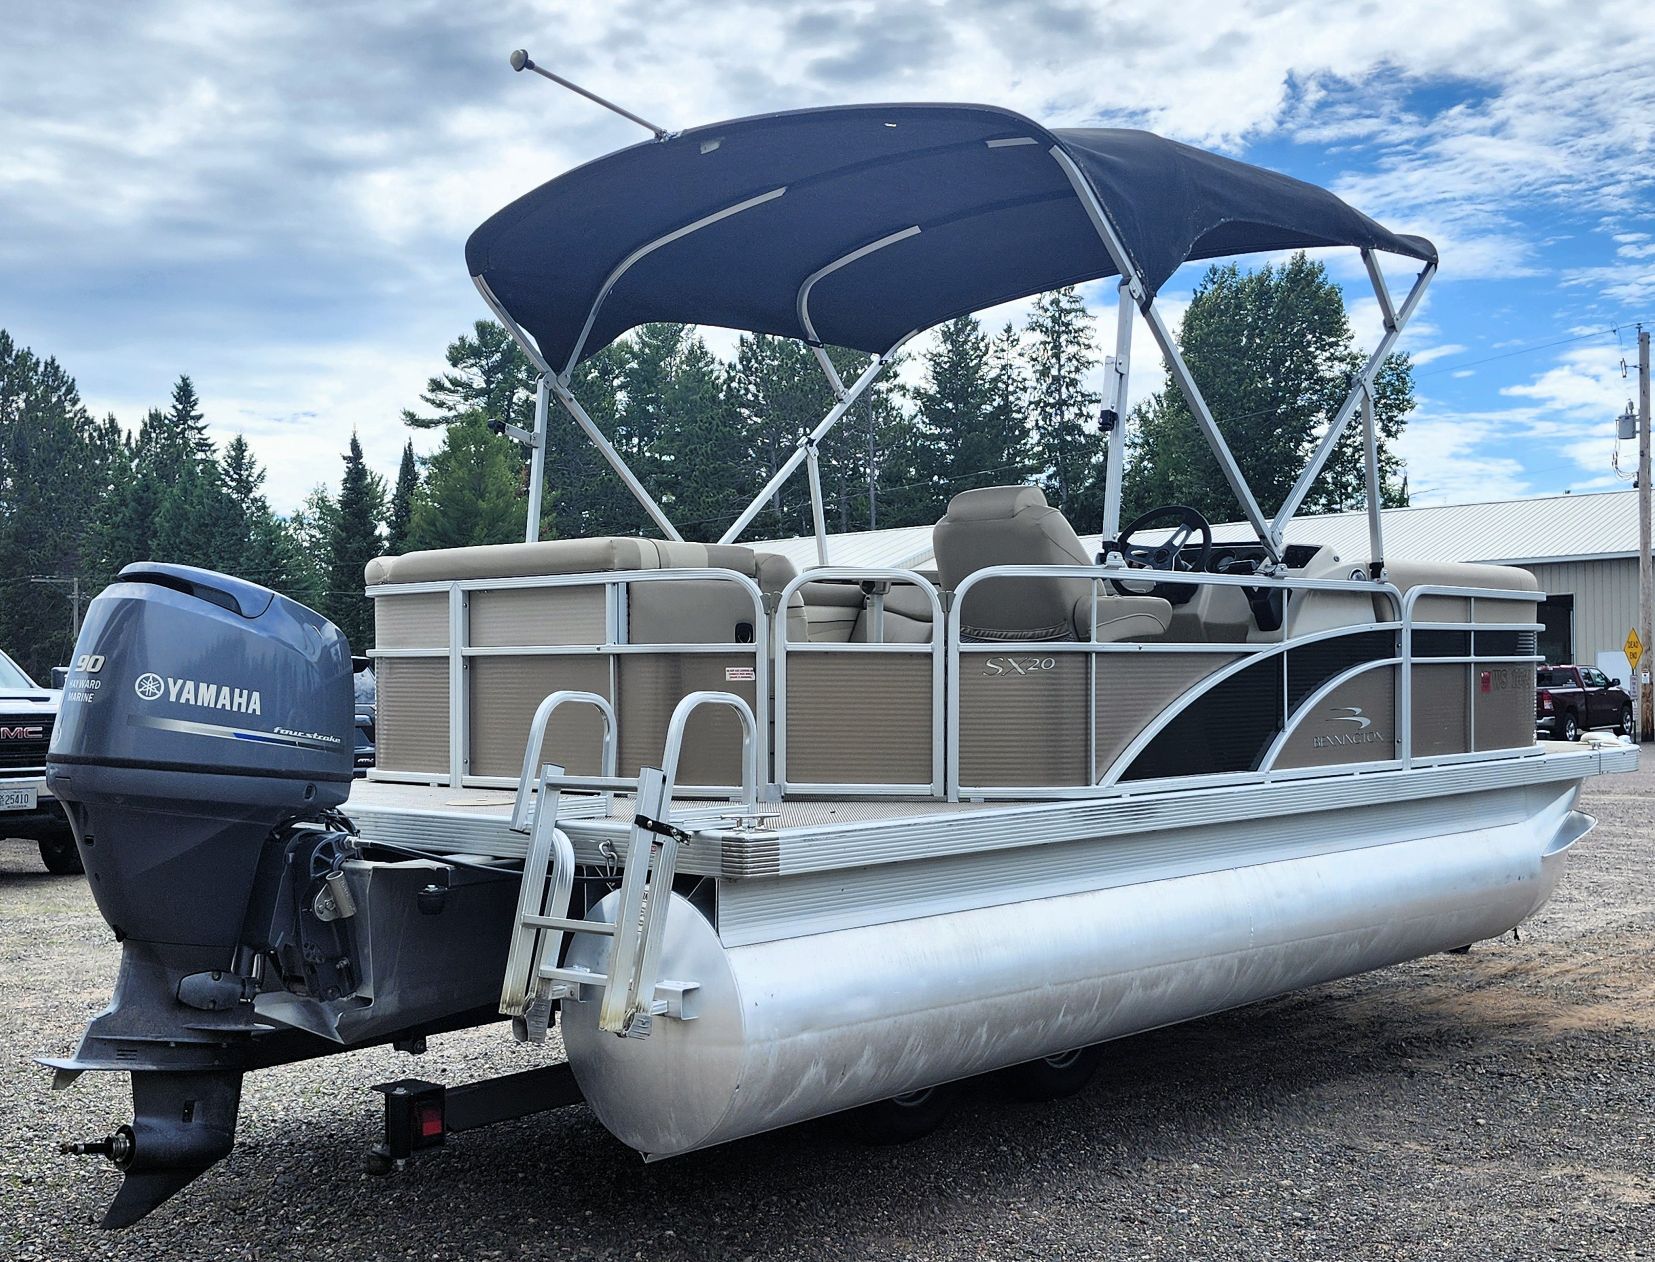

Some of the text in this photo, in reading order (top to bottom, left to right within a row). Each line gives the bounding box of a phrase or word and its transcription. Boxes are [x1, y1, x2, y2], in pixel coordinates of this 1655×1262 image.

[1627, 641, 1639, 649] DEAD
[1629, 652, 1638, 660] END
[75, 654, 106, 673] 90
[982, 656, 1056, 676] SX20
[69, 679, 101, 690] HAYWARD
[67, 692, 95, 703] MARINE
[167, 677, 261, 715] YAMAHA
[0, 726, 43, 739] MC
[1313, 731, 1384, 748] BENNINGTON
